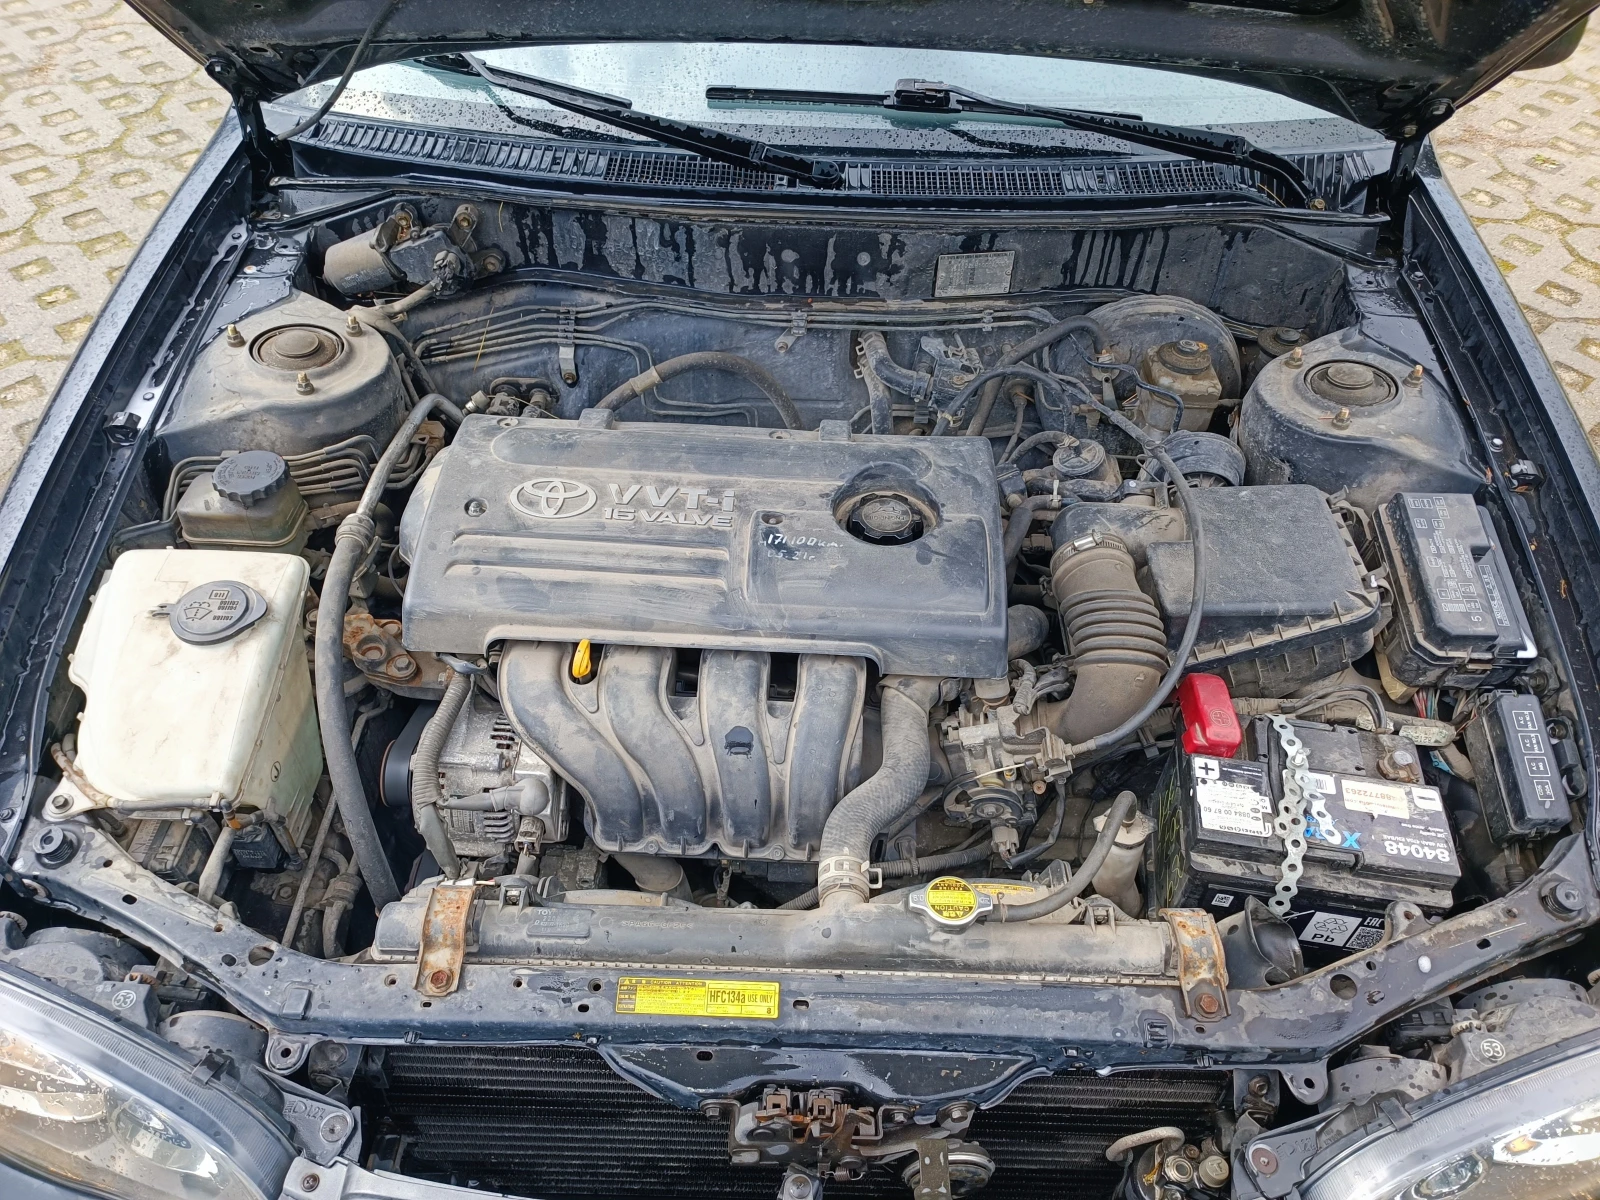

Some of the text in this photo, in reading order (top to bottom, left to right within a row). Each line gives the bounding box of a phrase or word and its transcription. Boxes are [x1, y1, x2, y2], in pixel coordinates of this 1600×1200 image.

[608, 483, 736, 513] VVT-i
[604, 507, 734, 528] 16 VALVE
[1383, 840, 1451, 862] 84048
[1311, 933, 1335, 943] Pb
[114, 992, 134, 1007] 53
[709, 989, 773, 1004] HFC134a USE ONLY
[1483, 1042, 1503, 1057] 53
